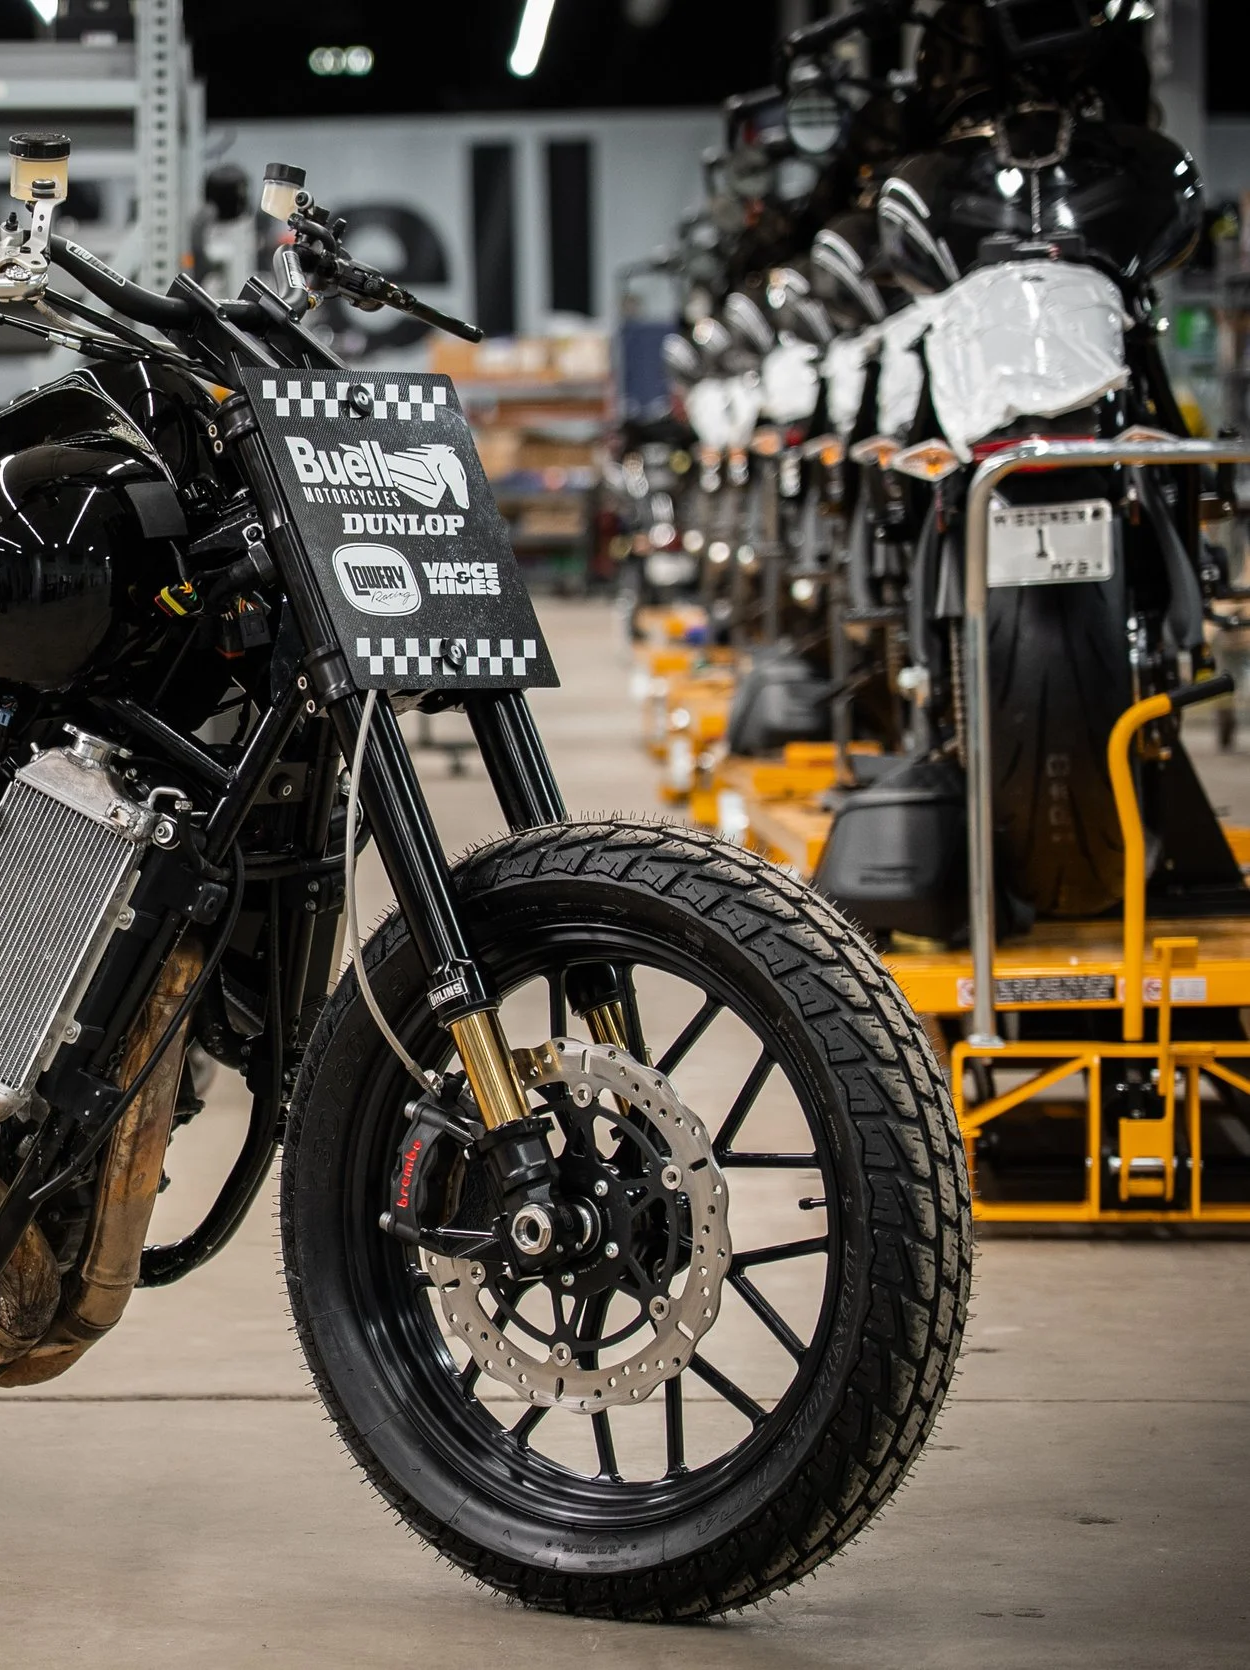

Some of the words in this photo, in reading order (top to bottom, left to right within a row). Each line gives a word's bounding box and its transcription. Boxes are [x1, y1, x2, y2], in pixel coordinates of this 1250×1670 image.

[285, 436, 395, 487] Buell
[303, 487, 401, 507] MOTORCYCLES
[342, 513, 464, 535] DUNLOP
[343, 561, 407, 596] LOWERY
[421, 562, 499, 579] VANCE
[429, 578, 501, 596] HINES
[396, 1138, 423, 1209] brembo
